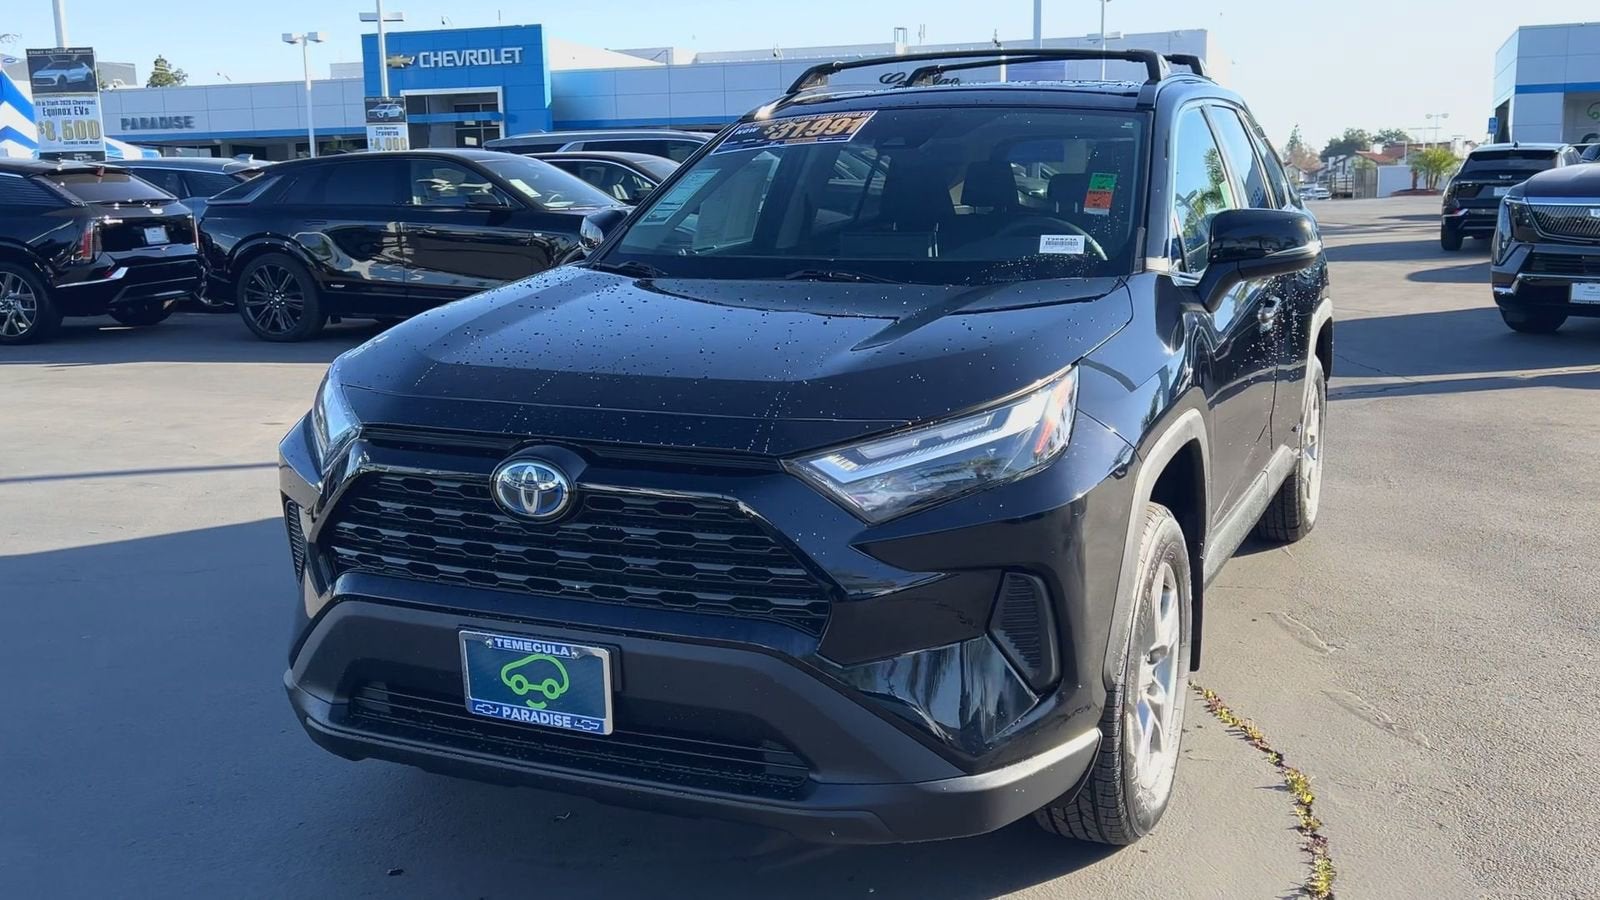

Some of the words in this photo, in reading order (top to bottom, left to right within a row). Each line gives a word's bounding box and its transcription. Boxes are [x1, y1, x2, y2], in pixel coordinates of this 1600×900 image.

[419, 47, 522, 68] CHEVROLET
[42, 107, 72, 118] Equinox
[74, 106, 90, 116] EVs
[120, 116, 195, 130] PARADISE
[494, 638, 571, 657] TEMECULA
[502, 706, 572, 728] PARADISE
